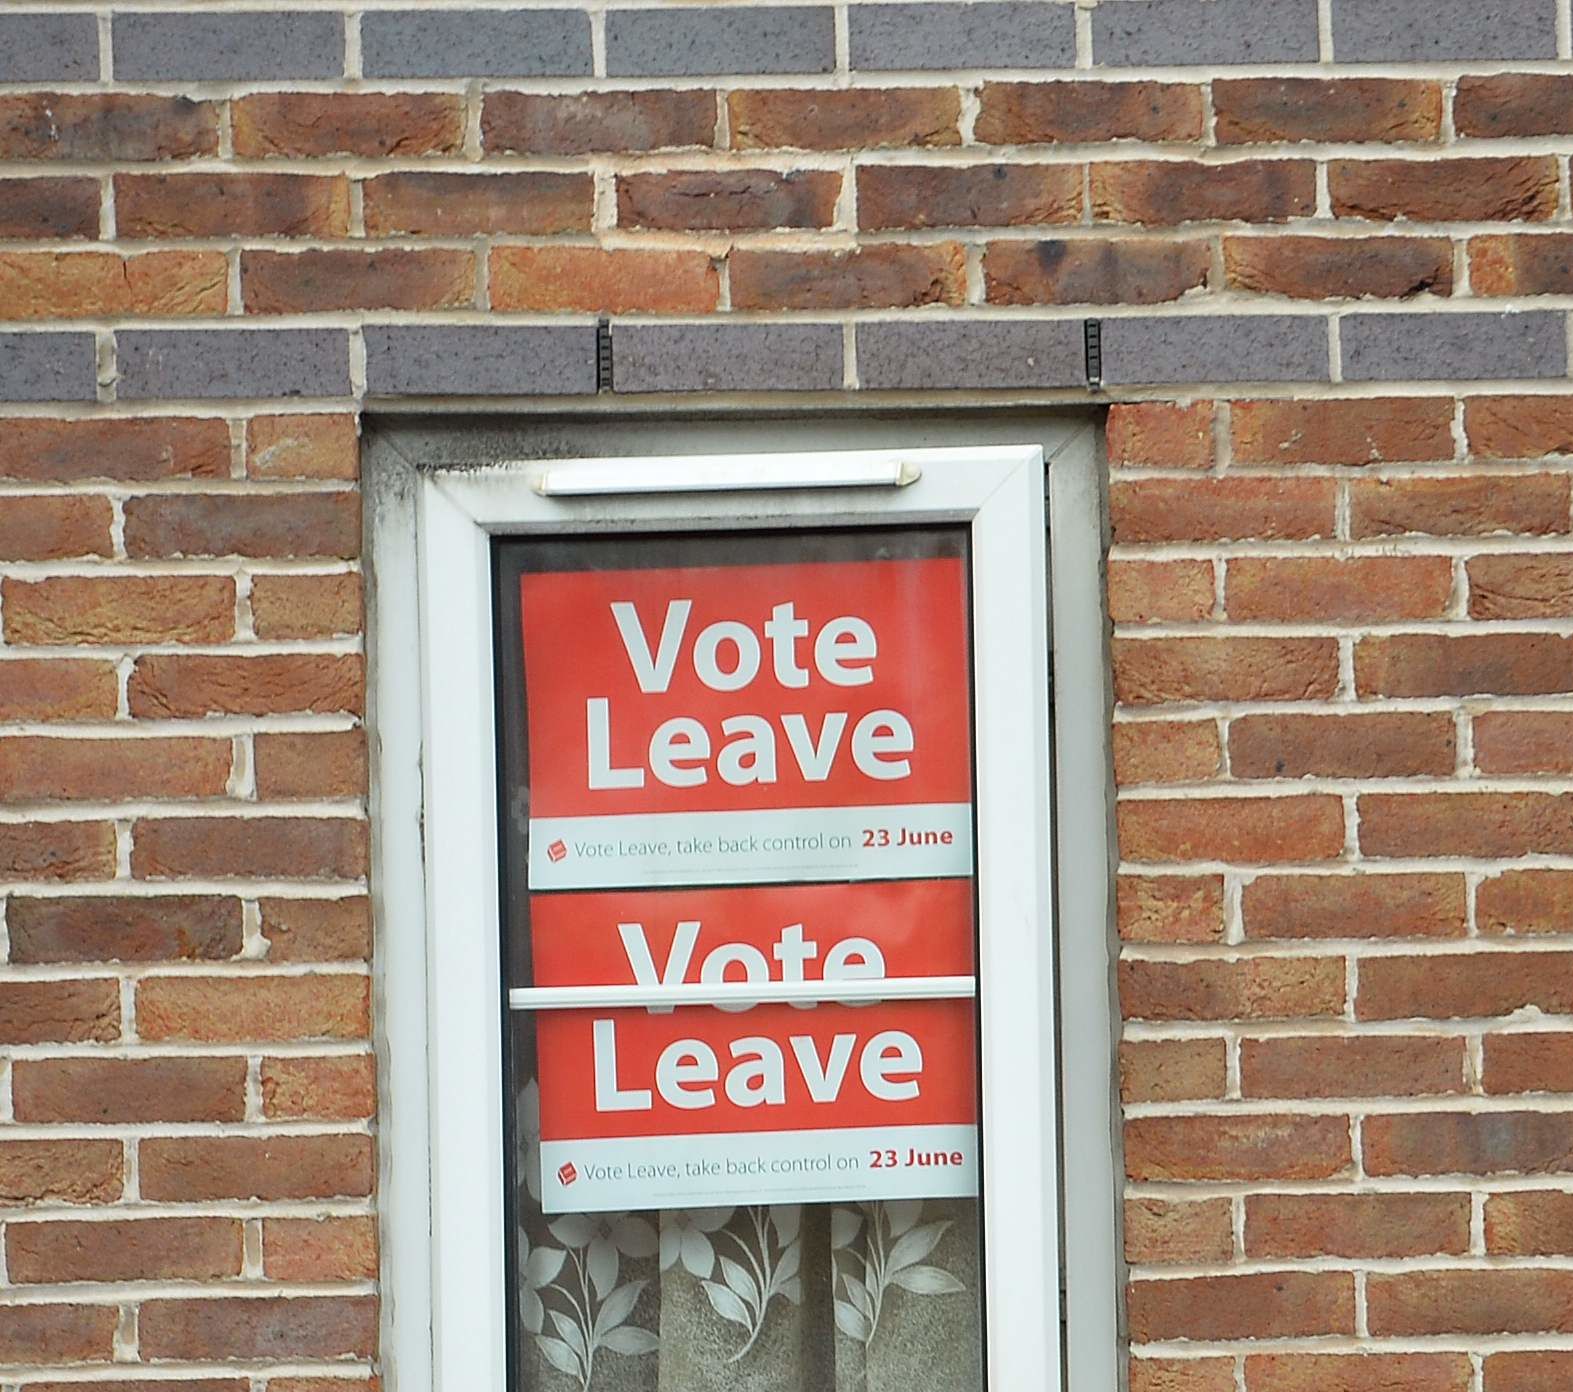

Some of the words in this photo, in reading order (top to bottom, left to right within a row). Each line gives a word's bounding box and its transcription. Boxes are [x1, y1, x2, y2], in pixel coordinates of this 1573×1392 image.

[610, 599, 877, 694] Vote
[586, 697, 914, 790] Leave
[575, 841, 613, 858] Vote
[619, 838, 673, 857] Leave,
[677, 836, 713, 855] take
[718, 834, 758, 854] back
[763, 832, 823, 852] control
[829, 835, 851, 850] on
[862, 829, 890, 847] 23
[897, 828, 953, 847] June
[618, 921, 886, 1014] Vote
[593, 1019, 924, 1112] Leave
[584, 1163, 623, 1181] Vote
[628, 1161, 681, 1180] Leave,
[685, 1159, 721, 1176] take
[726, 1157, 766, 1175] back
[771, 1153, 831, 1174] control
[836, 1155, 859, 1170] on
[869, 1150, 898, 1168] 23
[905, 1148, 963, 1167] June
